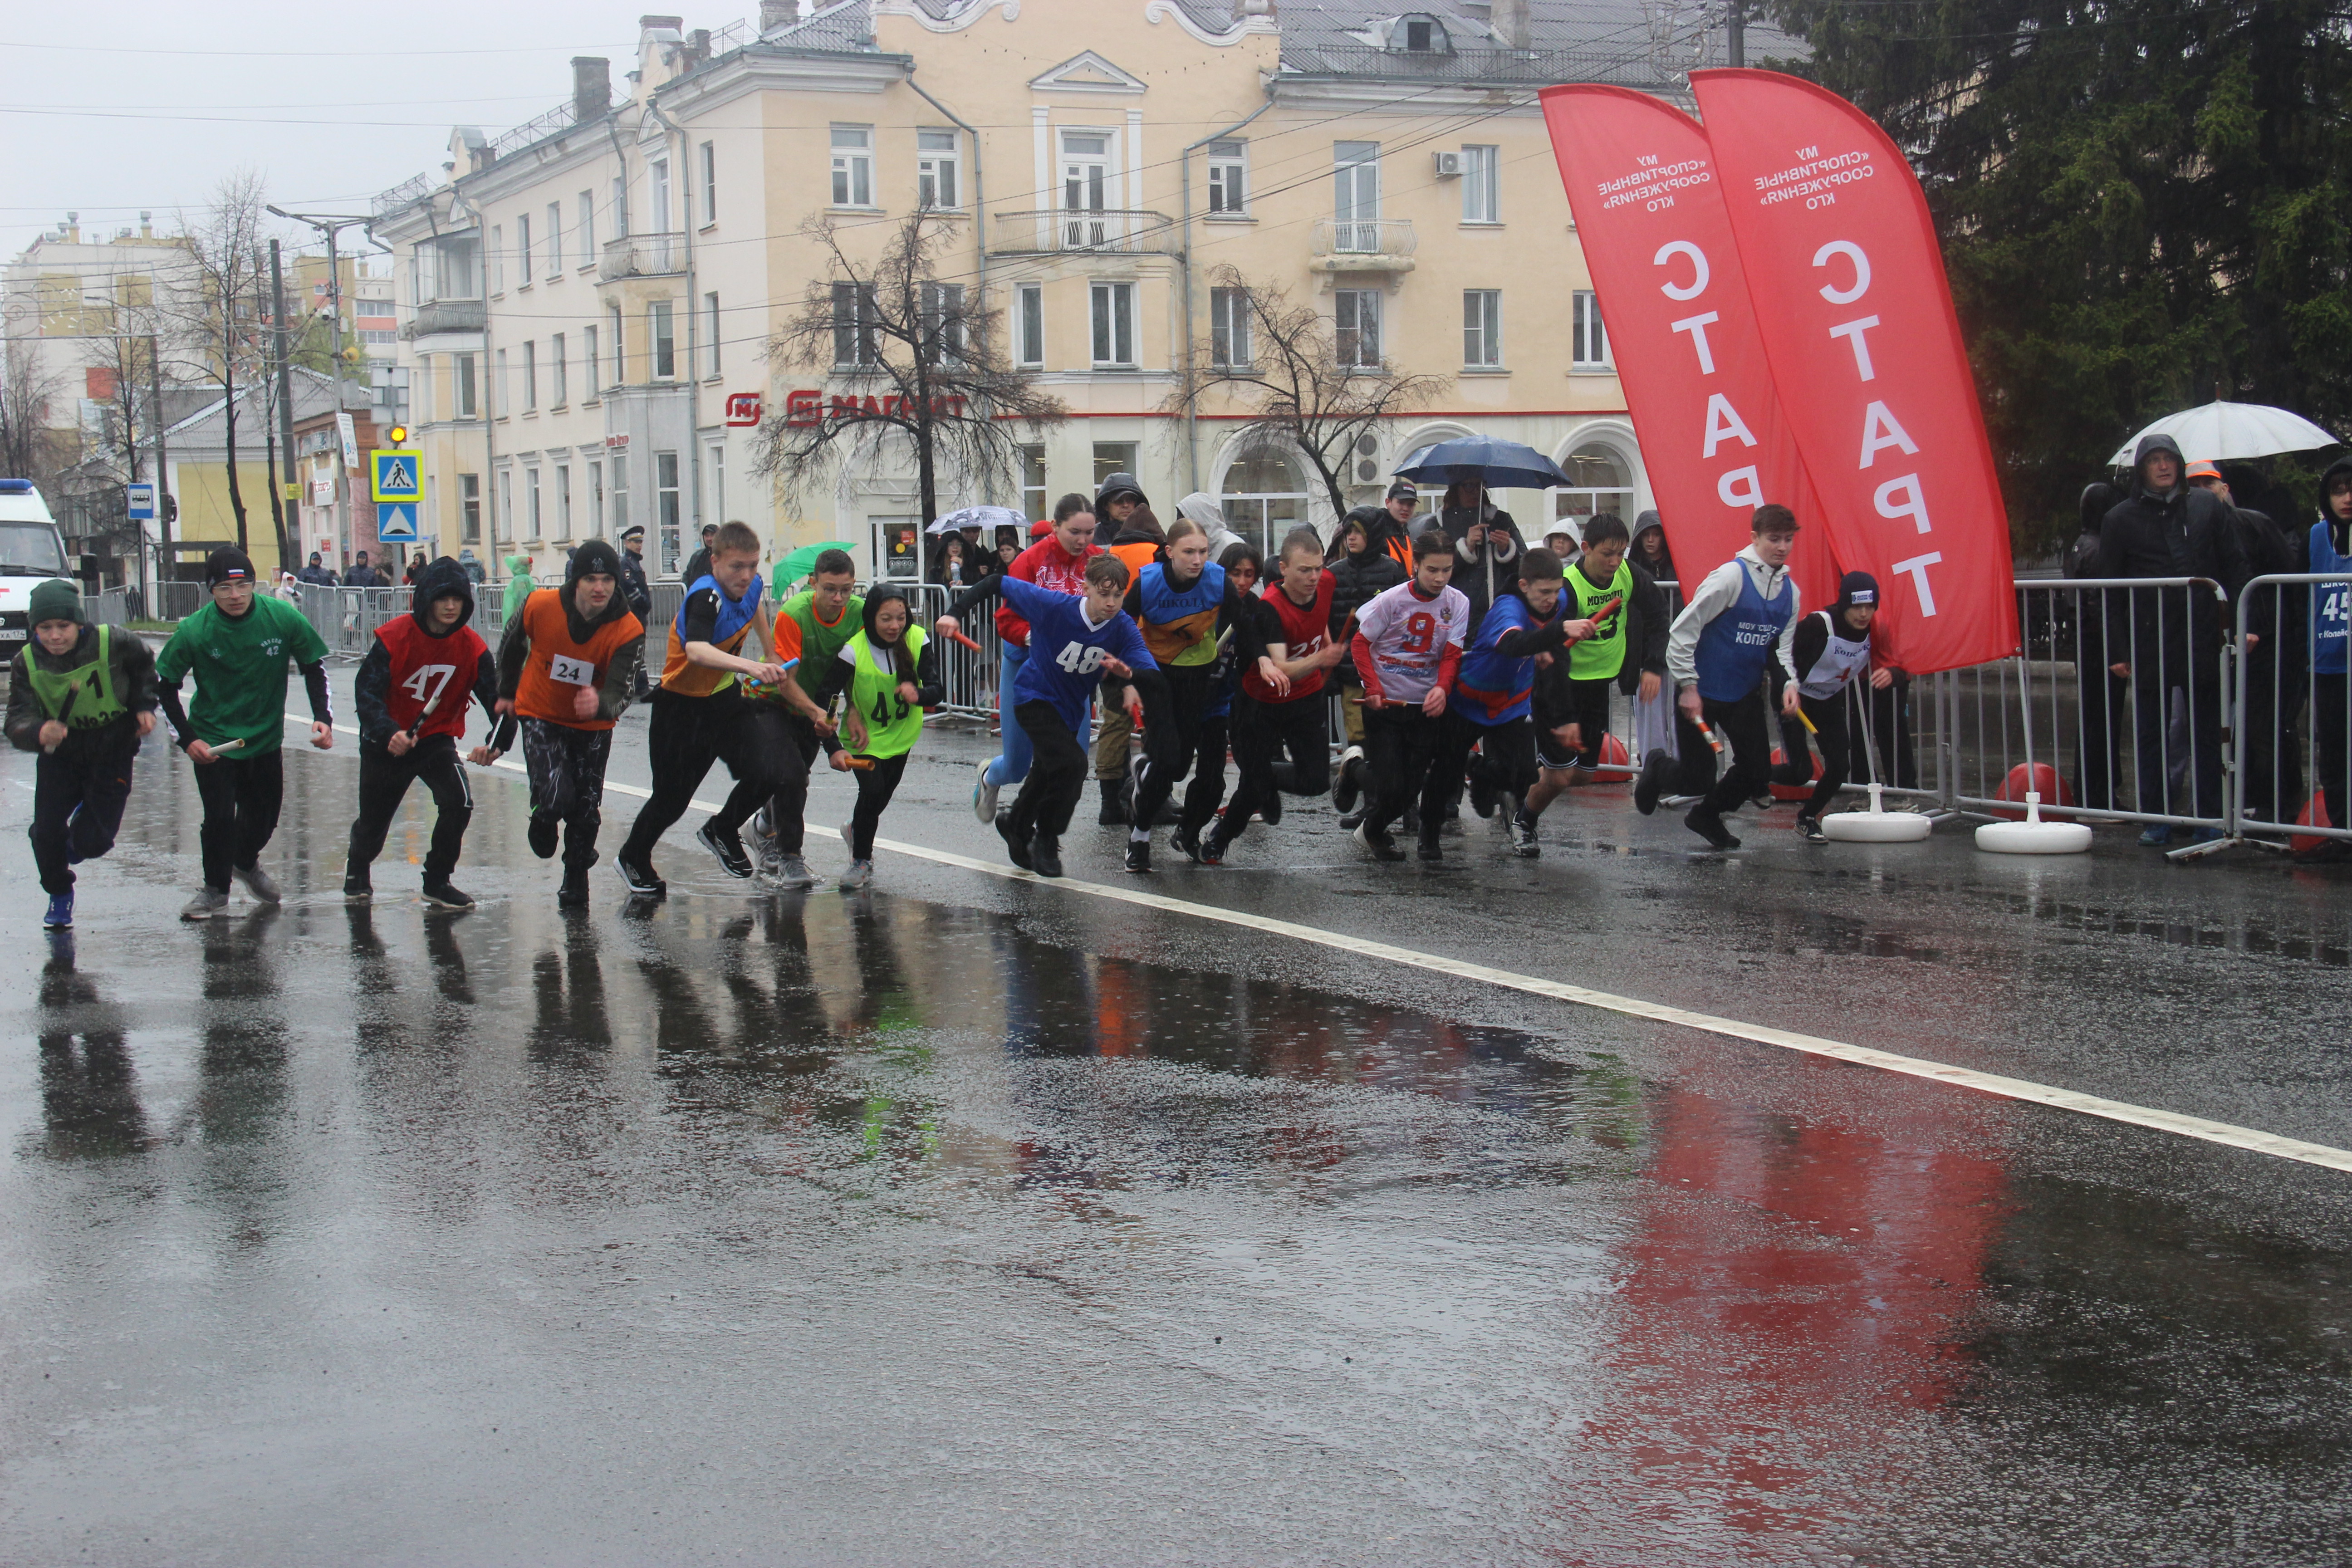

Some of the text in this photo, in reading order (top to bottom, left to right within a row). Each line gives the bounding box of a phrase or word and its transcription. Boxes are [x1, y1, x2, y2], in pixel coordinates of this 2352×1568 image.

[1158, 598, 1206, 608] ШКОЛА
[1402, 612, 1436, 653] 9
[1738, 622, 1756, 630] МОУ
[2323, 628, 2352, 638] Копейс
[266, 645, 279, 657] 42
[1056, 640, 1106, 674] 48
[1286, 635, 1322, 662] 23
[402, 664, 456, 702] 47
[557, 663, 580, 681] 24
[871, 691, 910, 728] 48
